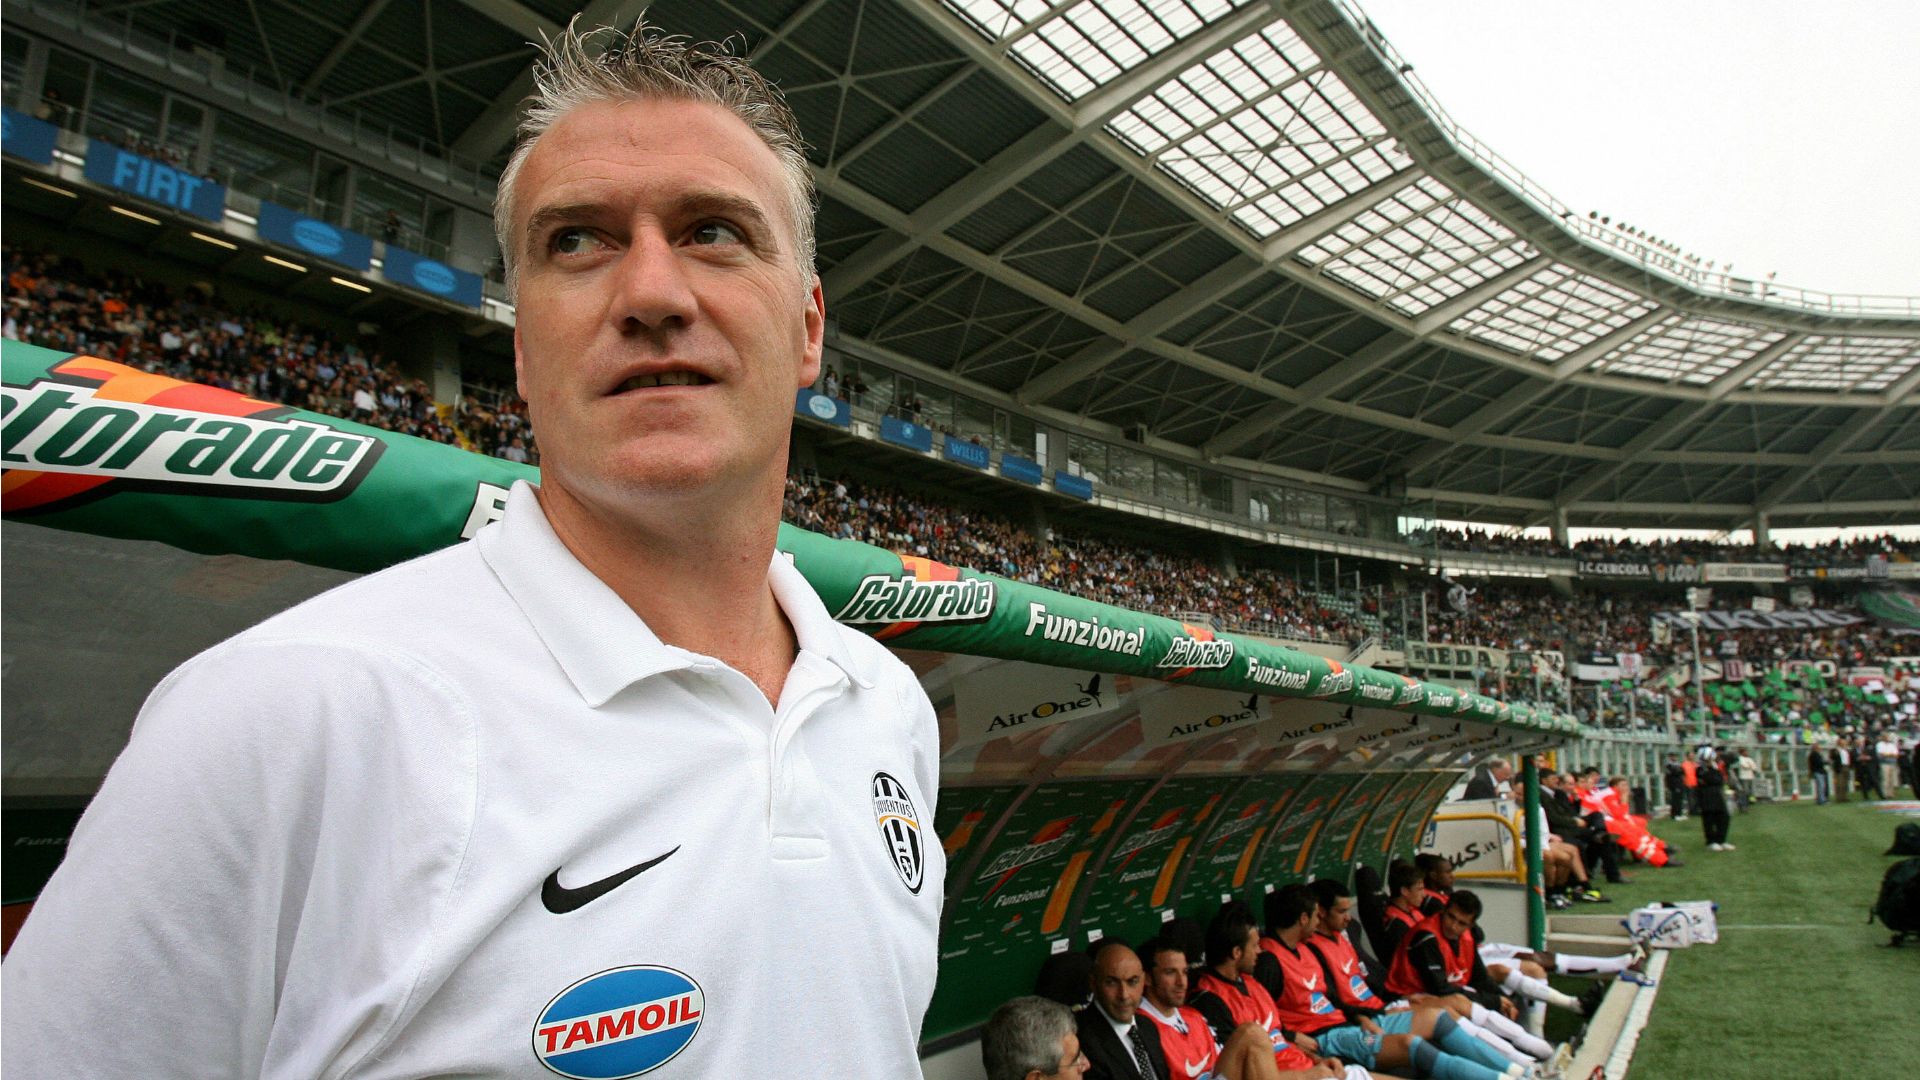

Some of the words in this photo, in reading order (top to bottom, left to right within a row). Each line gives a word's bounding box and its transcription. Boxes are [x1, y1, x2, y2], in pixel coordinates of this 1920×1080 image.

[113, 151, 203, 211] FIAT
[0, 389, 359, 485] torade
[837, 577, 991, 622] Gatorade
[1025, 602, 1145, 656] Funziona!
[1158, 637, 1233, 667] Gatorade
[1245, 657, 1311, 689] Funziona!
[876, 799, 912, 818] JUVENTUS
[538, 995, 701, 1053] TAMOIL
